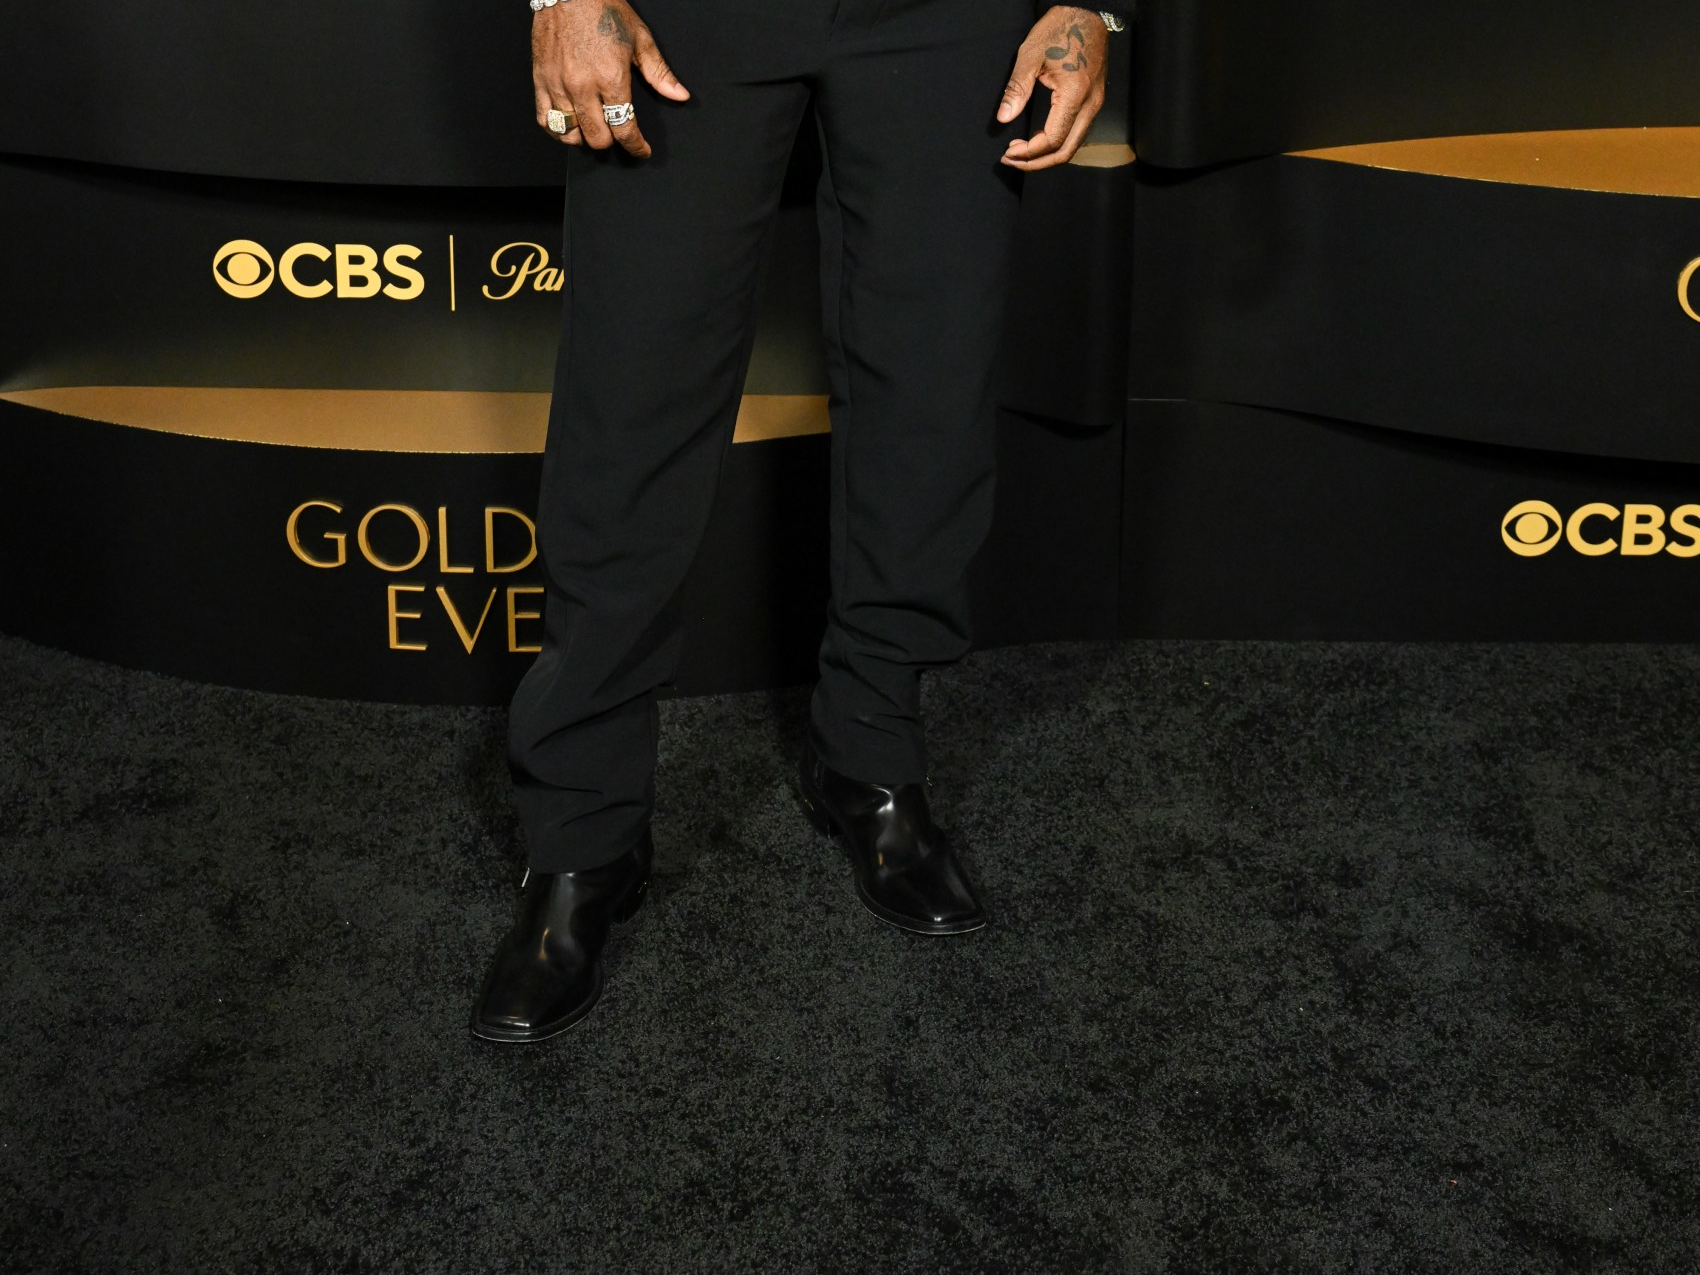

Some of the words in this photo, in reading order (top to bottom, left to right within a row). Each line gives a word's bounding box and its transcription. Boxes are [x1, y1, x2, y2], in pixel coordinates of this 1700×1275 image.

[278, 242, 425, 301] CBS
[286, 499, 539, 574] GOLD
[1565, 501, 1700, 558] CBS
[387, 584, 546, 655] EVE
